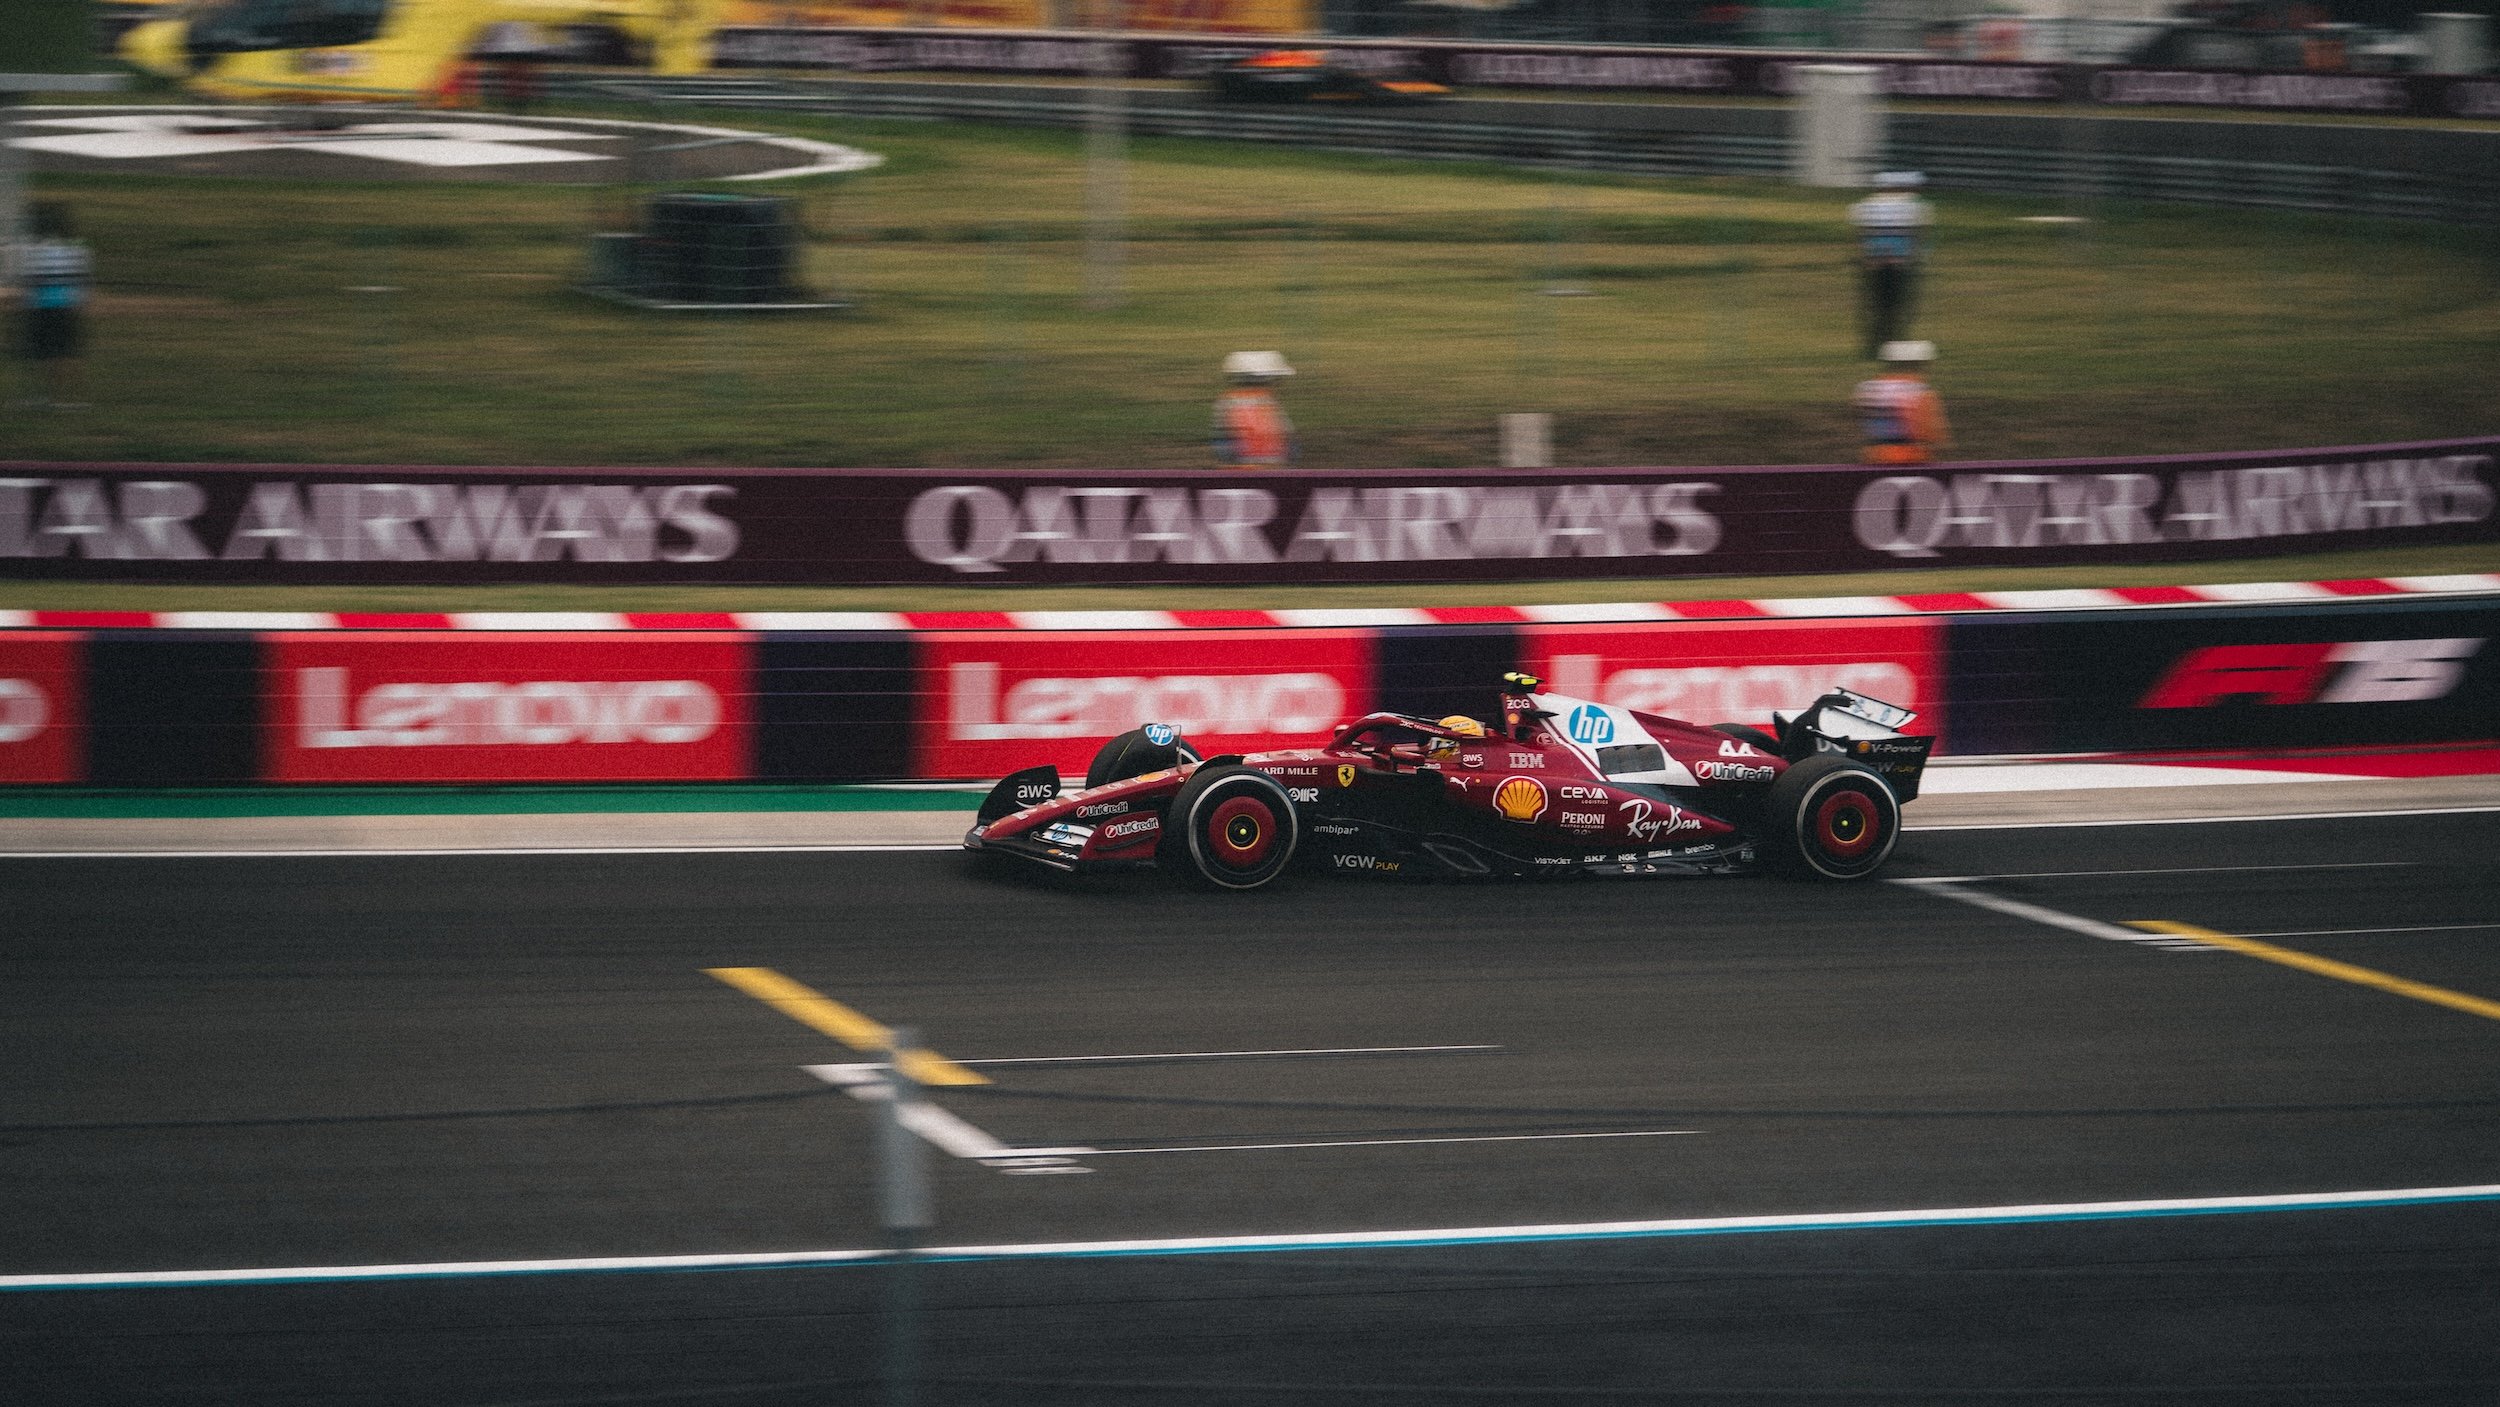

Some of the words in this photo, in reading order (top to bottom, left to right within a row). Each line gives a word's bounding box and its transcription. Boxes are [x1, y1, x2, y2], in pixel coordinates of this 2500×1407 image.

[904, 485, 1283, 572] QATAR
[1571, 704, 1613, 744] hp
[1149, 724, 1171, 745] hp
[1462, 753, 1484, 763] aws
[1509, 752, 1545, 769] IBM
[1259, 767, 1285, 775] ARD
[1287, 767, 1319, 776] MILLE
[1712, 762, 1775, 780] UniCredit
[1016, 783, 1053, 799] aws
[1088, 801, 1128, 817] UniCredit
[1116, 817, 1159, 836] UniCredit
[1560, 811, 1606, 825] PERONI
[1333, 854, 1377, 869] VGW
[1375, 861, 1400, 871] PLAY
[1618, 853, 1638, 861] NGK
